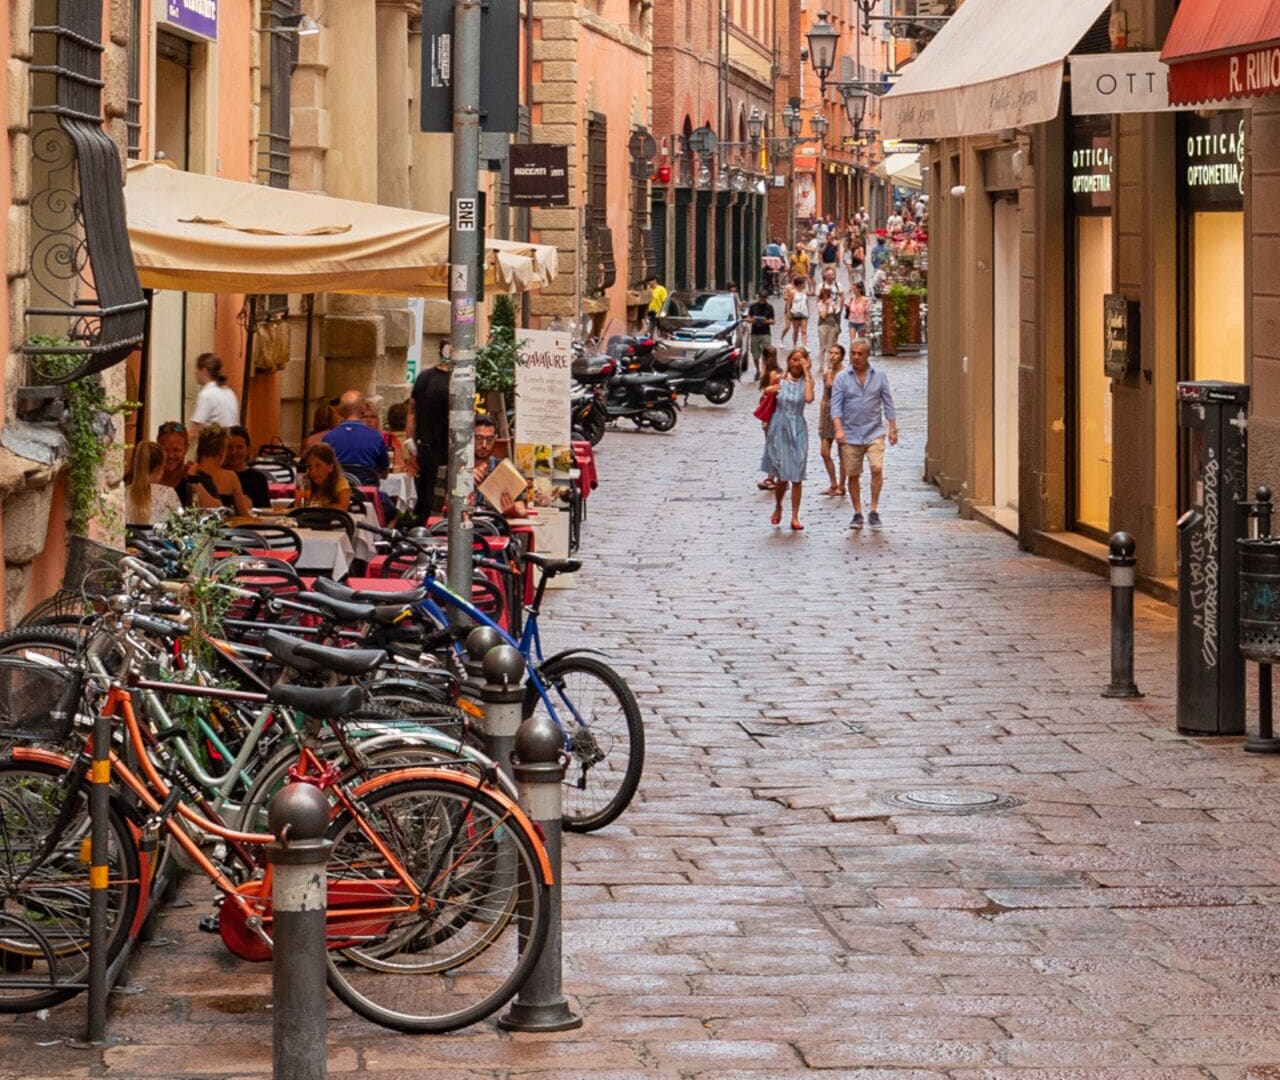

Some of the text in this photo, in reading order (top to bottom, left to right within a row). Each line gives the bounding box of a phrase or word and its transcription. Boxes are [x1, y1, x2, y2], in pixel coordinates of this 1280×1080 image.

[1229, 56, 1243, 93] R.
[1187, 133, 1236, 157] OTTICA
[1072, 148, 1109, 168] OTTICA
[1072, 174, 1111, 193] OPTOMETRIA
[1187, 163, 1239, 186] OPTOMETRIA
[459, 201, 474, 229] BNE
